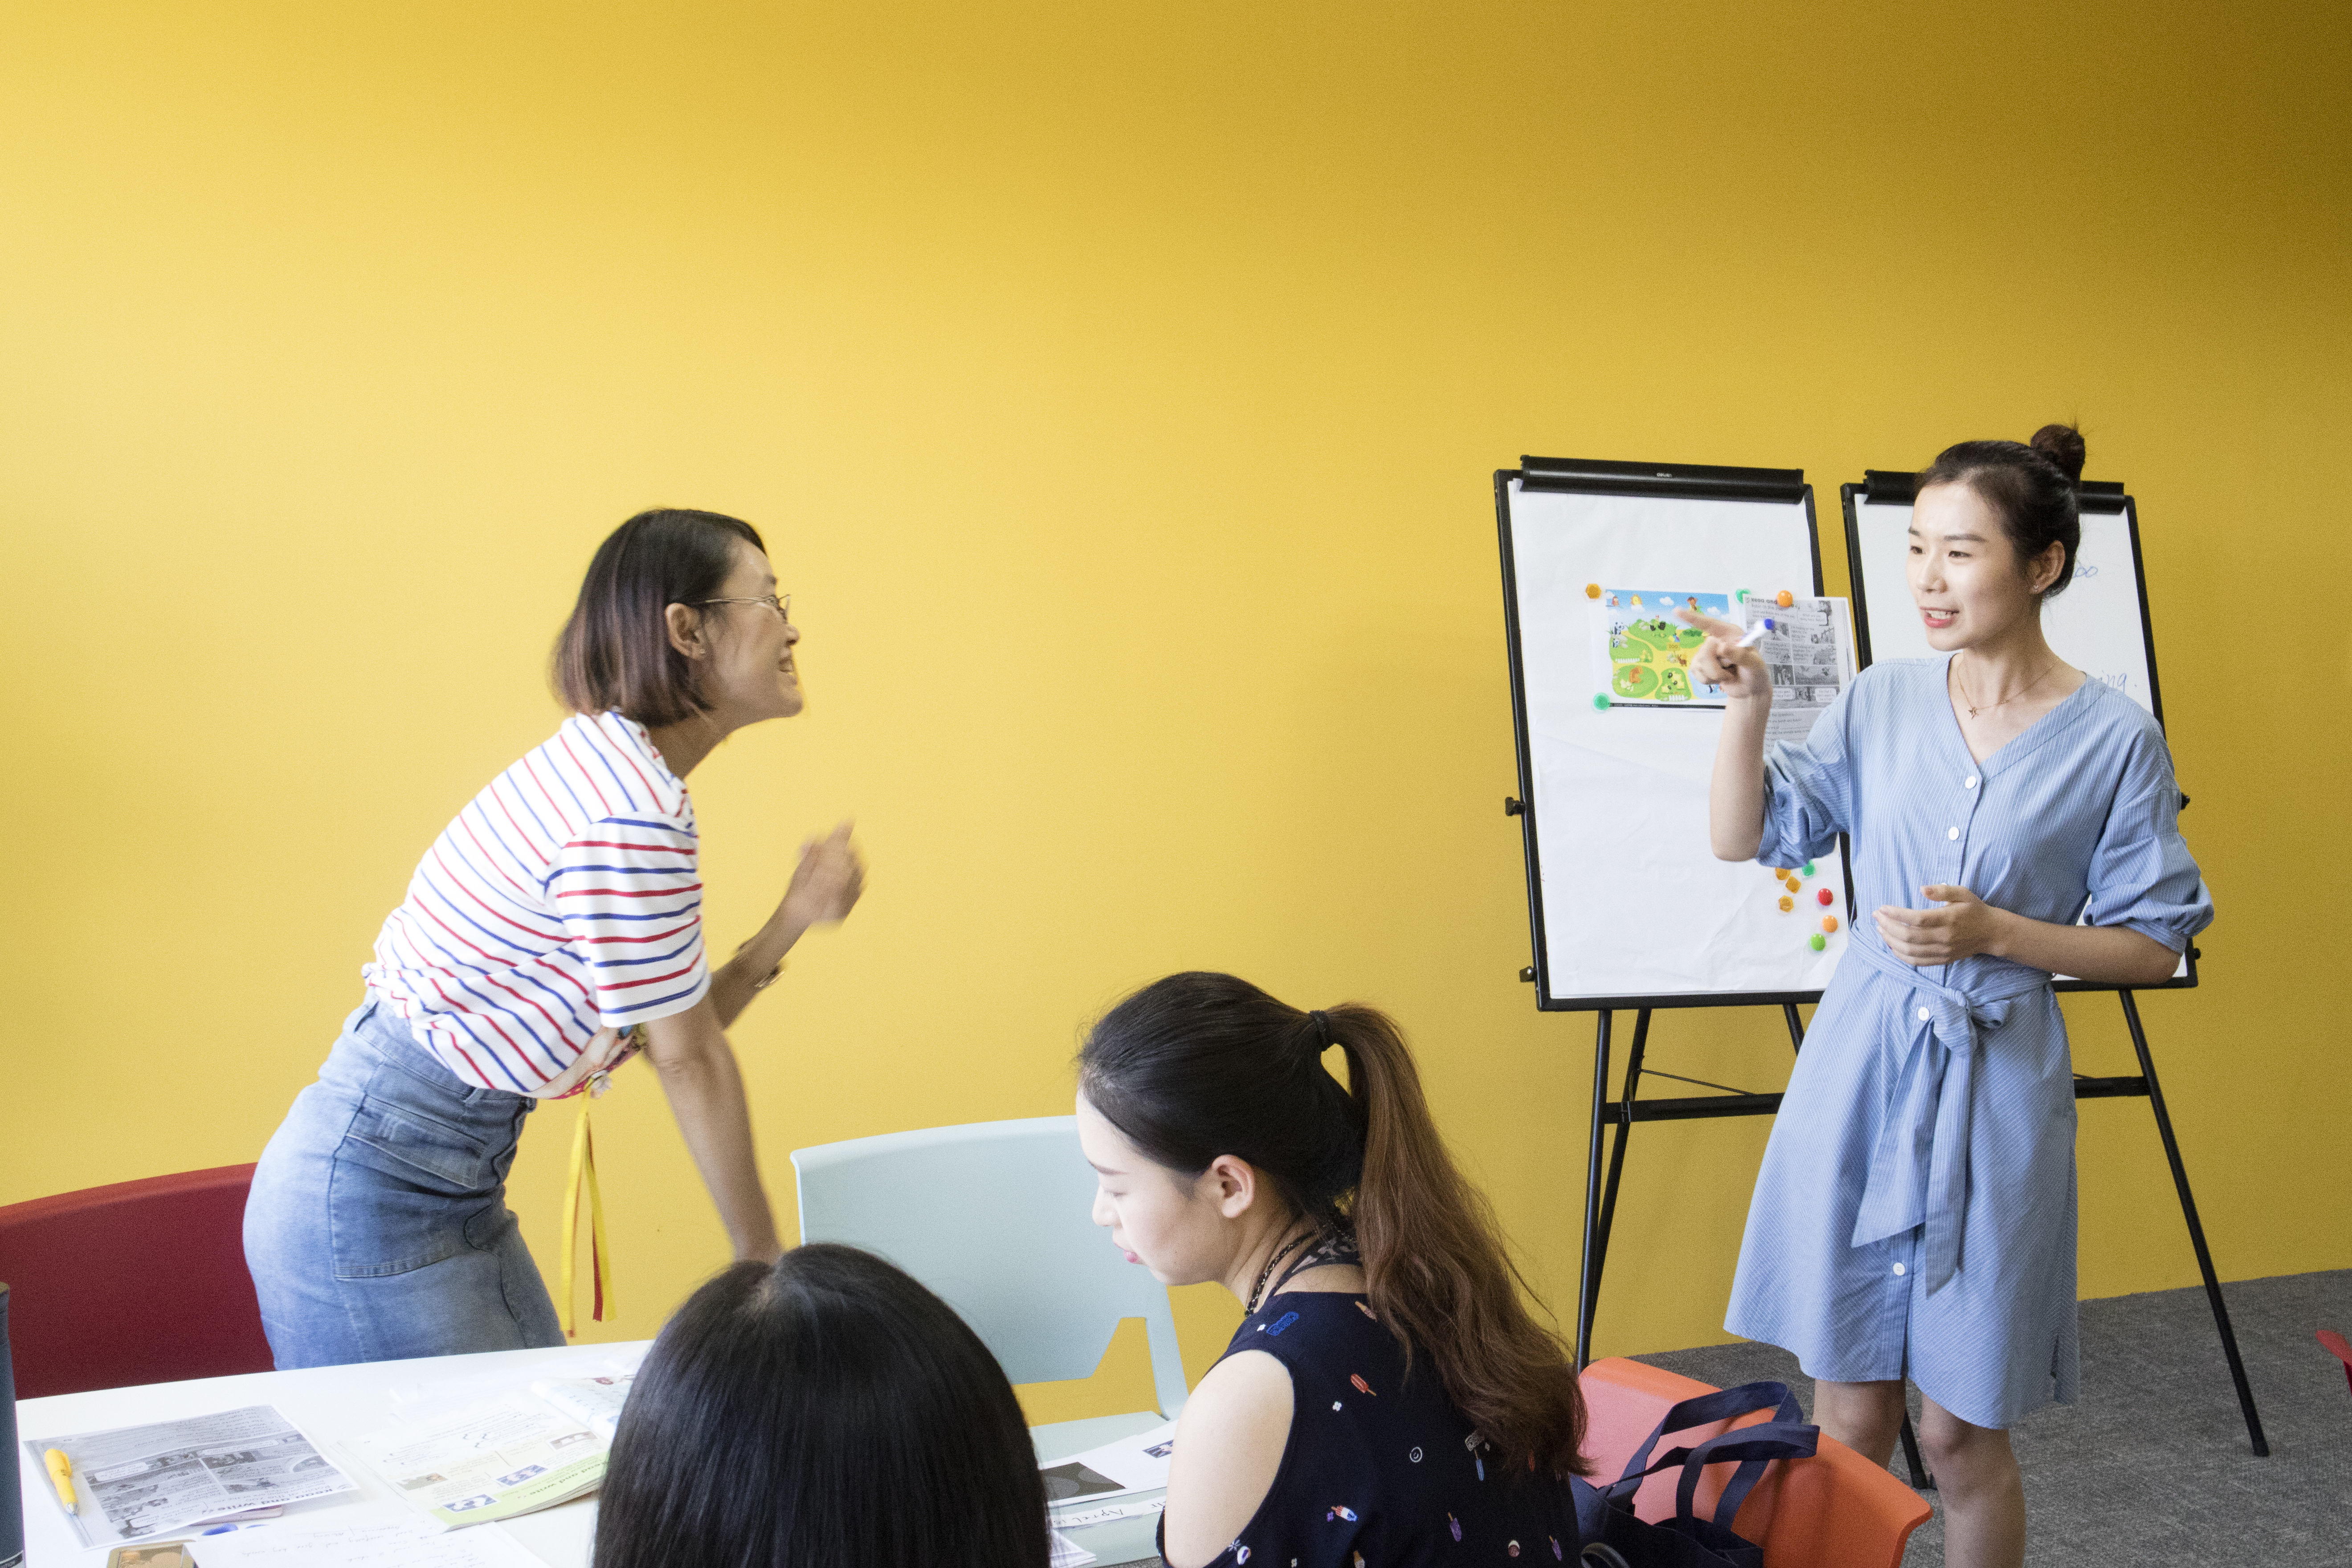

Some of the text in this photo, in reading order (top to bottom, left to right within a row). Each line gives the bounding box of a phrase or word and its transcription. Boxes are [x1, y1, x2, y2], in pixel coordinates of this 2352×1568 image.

[557, 1472, 580, 1483] and
[528, 1482, 557, 1495] write
[216, 1502, 257, 1511] write
